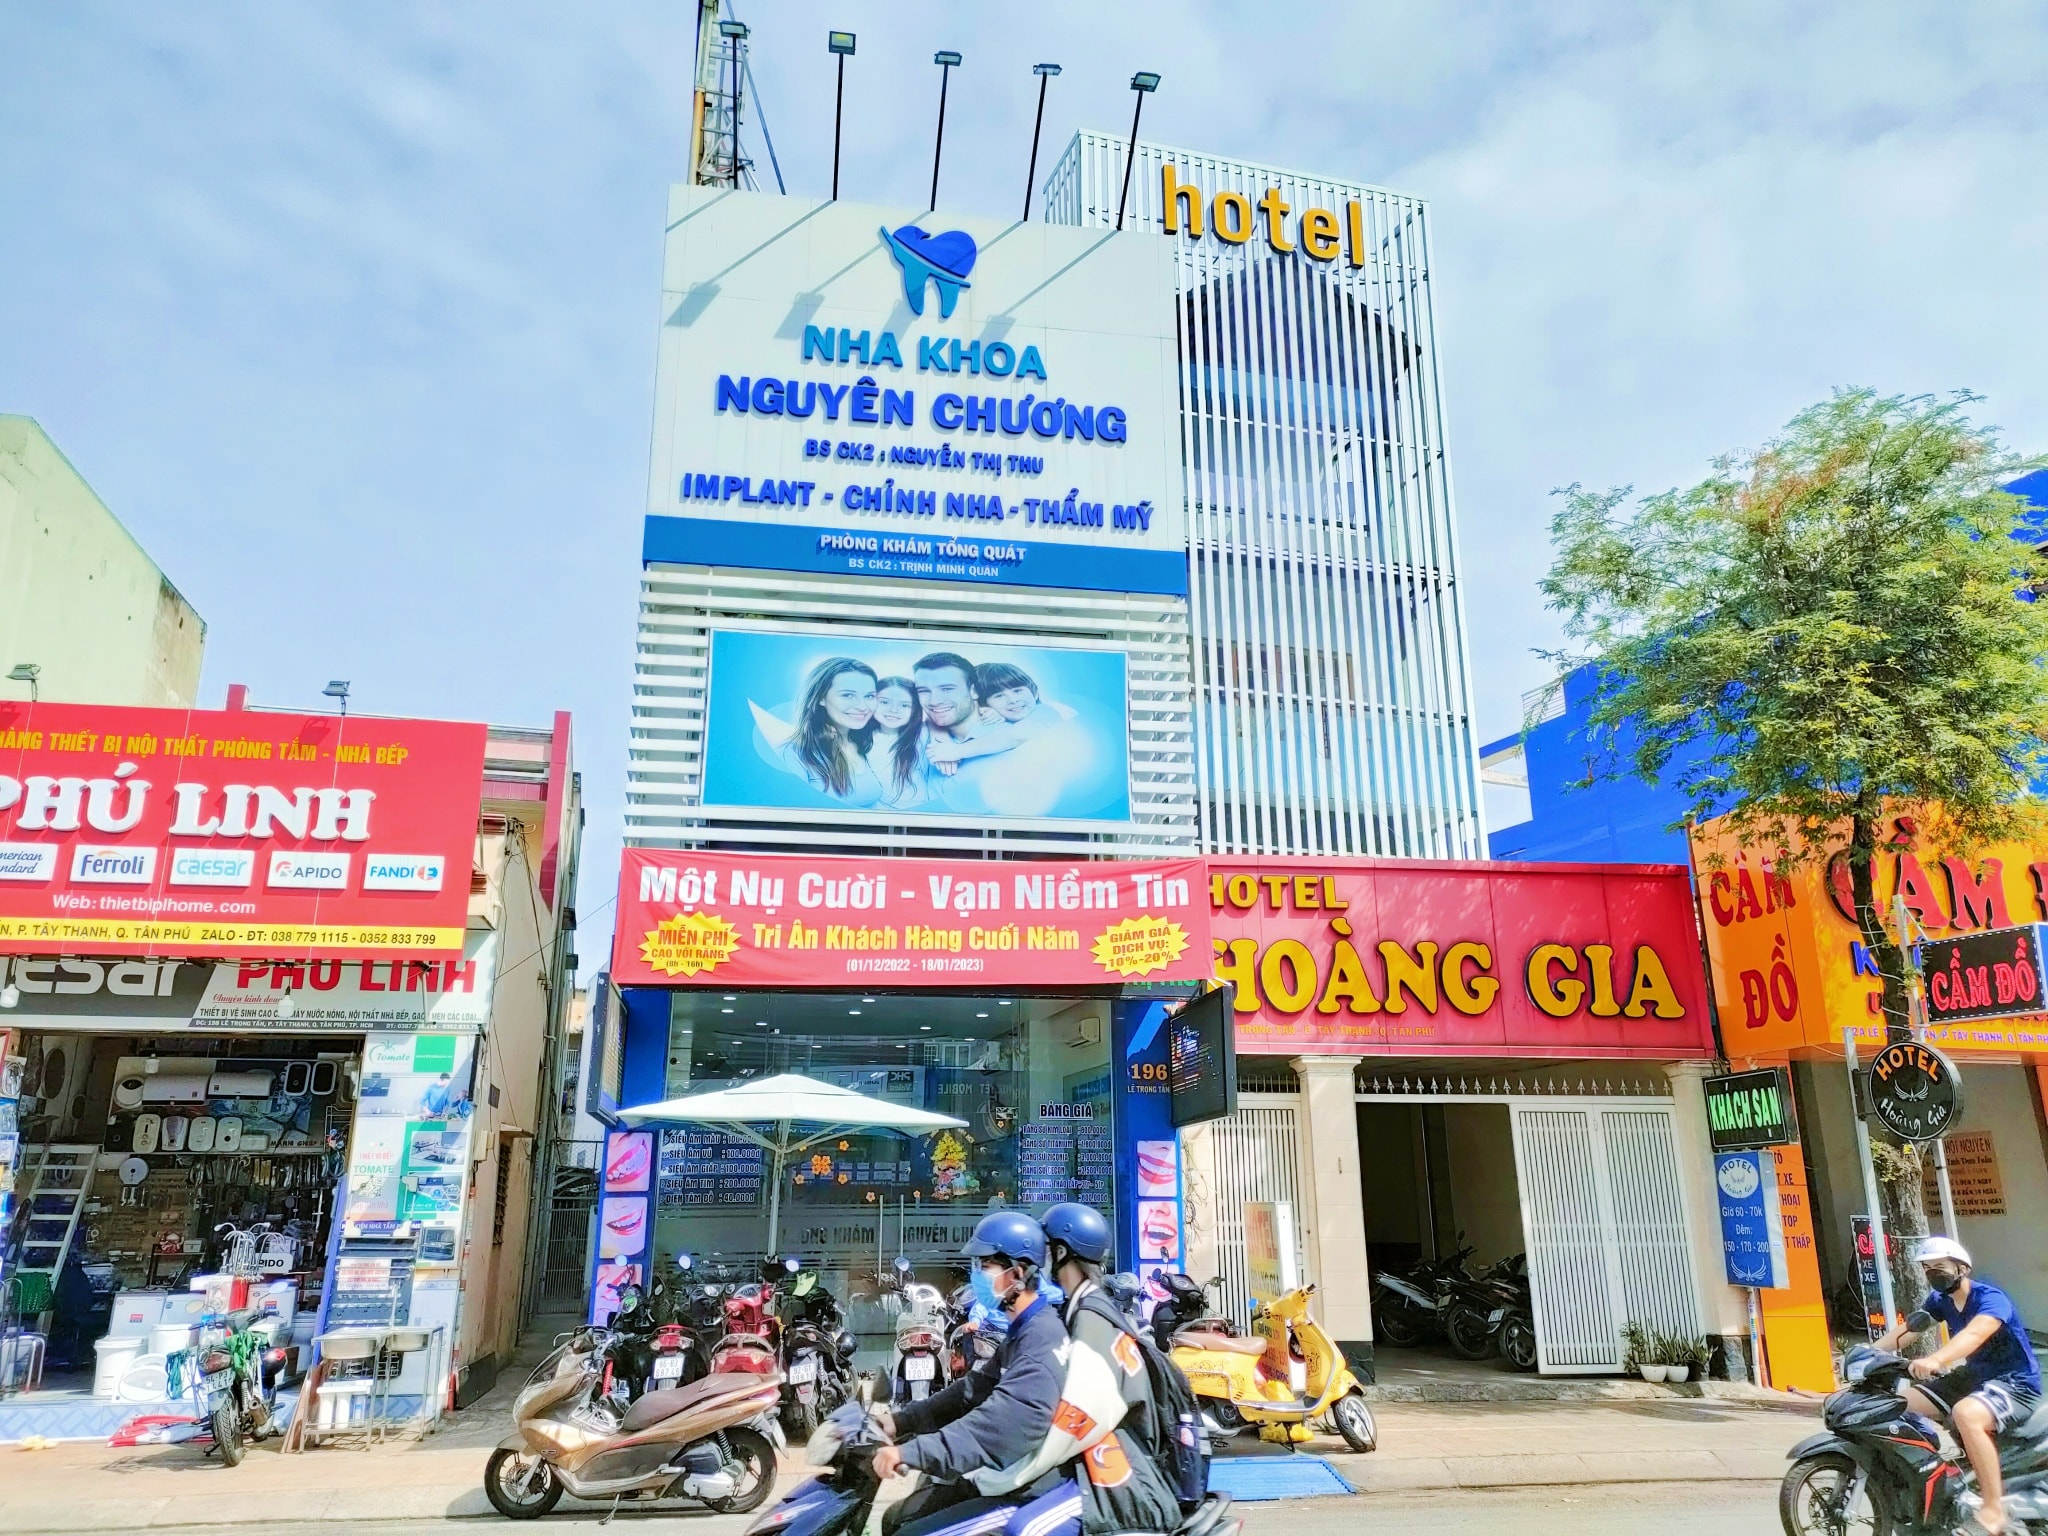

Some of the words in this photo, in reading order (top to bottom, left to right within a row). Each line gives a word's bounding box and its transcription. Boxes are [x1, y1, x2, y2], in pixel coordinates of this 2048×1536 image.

[1162, 164, 1365, 269] hotel
[804, 325, 903, 368] NHA
[919, 336, 1047, 380] KHOA
[718, 375, 914, 425] NGUYÊN
[933, 393, 1127, 443] CHƯƠNG
[806, 439, 831, 457] BS
[837, 442, 874, 461] CK2
[891, 443, 965, 468] NGUYỄN
[972, 452, 1001, 476] THỊ
[1007, 455, 1044, 473] THU
[683, 473, 816, 506] IMPLANT
[844, 478, 936, 515] CHỈNH
[947, 492, 1004, 520] NHA
[1024, 488, 1104, 526] THẨM
[1113, 501, 1154, 530] MỸ
[820, 532, 877, 551] PHÒNG
[883, 537, 931, 555] KHÁM
[936, 536, 979, 557] TỔNG
[983, 544, 1026, 560] QUÁT
[849, 558, 864, 568] BS
[868, 559, 891, 570] CK2
[901, 561, 933, 574] TRỊNH
[937, 563, 964, 575] MINH
[969, 564, 998, 576] QUÂN
[0, 727, 43, 750] ÀNG
[50, 729, 98, 753] THIẾT
[103, 735, 122, 757] BỊ
[126, 733, 158, 758] NỘI
[164, 734, 209, 757] THẤT
[212, 736, 272, 760] PHÒNG
[279, 737, 317, 761] TẮM
[335, 742, 371, 763] NHÀ
[376, 742, 409, 765] BẾP
[168, 782, 376, 842] LINH
[176, 858, 247, 876] caesar
[639, 866, 717, 912] Một
[730, 870, 784, 914] Nụ
[798, 872, 887, 909] Cười
[928, 875, 1000, 917] Vạn
[1015, 868, 1118, 909] Niềm
[1131, 874, 1190, 907] Tin
[53, 894, 97, 910] Web:
[100, 896, 256, 915] thietbiplhome.com
[17, 924, 28, 936] P.
[33, 923, 59, 938] TÂY
[63, 925, 111, 940] THẠNH,
[116, 927, 129, 938] Q.
[134, 925, 162, 939] TÂN
[163, 926, 191, 940] PHÚ
[201, 929, 236, 941] ZALO
[247, 931, 267, 941] ĐT:
[271, 931, 292, 942] 038
[296, 931, 317, 942] 779
[321, 932, 348, 943] 1115
[359, 933, 387, 944] 0352
[391, 934, 411, 944] 833
[415, 934, 436, 945] 799
[658, 925, 697, 945] MIỄN
[703, 928, 728, 946] PHÍ
[753, 922, 782, 948] Tri
[788, 919, 818, 949] Ân
[825, 926, 897, 950] Khách
[905, 926, 962, 952] Hàng
[969, 922, 1020, 950] Cuối
[1028, 925, 1080, 950] Năm
[1109, 929, 1145, 942] GIẢM
[1149, 924, 1171, 938] GIÁ
[651, 948, 672, 960] CẠO
[676, 946, 693, 958] VÔI
[696, 947, 724, 959] RĂNG
[1112, 942, 1144, 956] DỊCH
[1148, 940, 1169, 951] VỤ:
[847, 958, 910, 972] (01/12/2022
[921, 958, 984, 972] 18/01/2023)
[1108, 951, 1174, 967] 10%-20%
[359, 960, 476, 993] LINH
[1525, 943, 1687, 1019] GIA
[1740, 933, 1798, 1029] ĐỒ
[1931, 948, 1991, 1012] CẦM
[1993, 937, 2037, 1004] ĐỒ
[245, 993, 262, 1003] kinh
[200, 1005, 220, 1017] THIẾT
[240, 1009, 257, 1018] SINH
[258, 1009, 272, 1018] CAO
[306, 1008, 325, 1019] NƯỚC
[326, 1008, 347, 1020] NÓNG,
[348, 1010, 361, 1021] NỘI
[362, 1008, 379, 1020] THẤT
[380, 1010, 394, 1020] NHÀ
[447, 1011, 460, 1020] CÁC
[231, 1020, 252, 1028] TRỌNG
[276, 1020, 287, 1028] TÂY
[1239, 1024, 1272, 1036] TRỌNG
[1340, 1025, 1372, 1038] THẠNH
[1953, 1030, 1969, 1041] TÂY
[2018, 1031, 2034, 1044] TÂN
[1131, 1063, 1168, 1080] 196
[1875, 1046, 1938, 1082] HOTEL
[1127, 1083, 1135, 1093] LÊ
[1136, 1085, 1157, 1095] TRỌNG
[1040, 1100, 1070, 1117] BẢNG
[1072, 1102, 1093, 1117] GIÁ
[1709, 1082, 1754, 1131] KHÁCH
[1752, 1086, 1782, 1138] SẠN
[354, 1165, 394, 1174] TOMATE
[1721, 1159, 1752, 1175] HOTEL
[700, 1178, 715, 1188] TIM
[1784, 1173, 1794, 1185] XE
[1722, 1206, 1734, 1217] Giờ
[1736, 1206, 1744, 1216] 60
[1750, 1205, 1763, 1217] 70k
[1735, 1223, 1753, 1236] Đêm:
[1724, 1241, 1735, 1252] 150
[1742, 1241, 1753, 1252] 170
[1757, 1241, 1769, 1252] 200
[1791, 1232, 1811, 1247] THẤP
[1863, 1260, 1872, 1269] XE
[1865, 1273, 1876, 1282] XE
